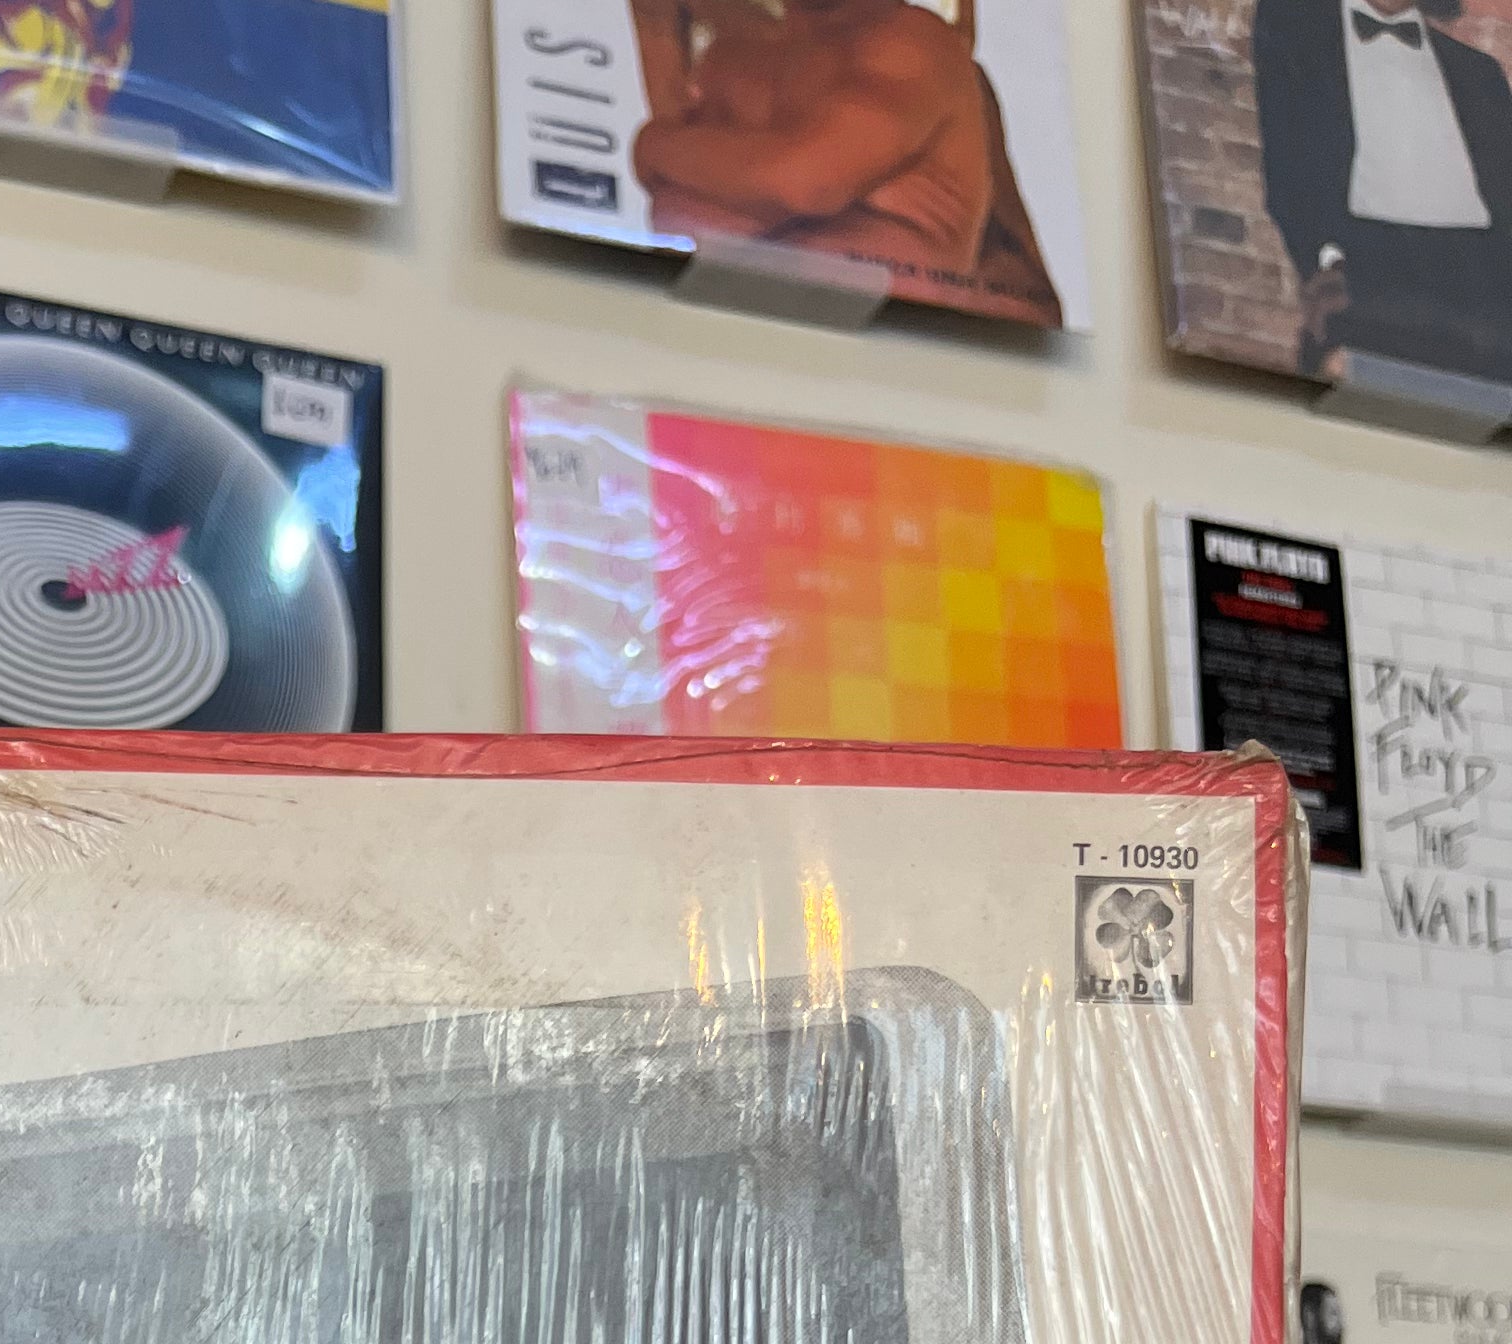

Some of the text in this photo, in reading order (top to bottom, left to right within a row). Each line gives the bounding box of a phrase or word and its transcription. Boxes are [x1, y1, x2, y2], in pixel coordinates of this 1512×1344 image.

[4, 300, 123, 344] QUEEN
[129, 325, 245, 366] QUEEN
[1362, 661, 1470, 741] PINK
[1362, 714, 1497, 809] FLOYD
[1073, 843, 1091, 865] T
[1119, 844, 1199, 871] 10930
[1386, 797, 1478, 870] THE
[1377, 860, 1512, 953] WALL
